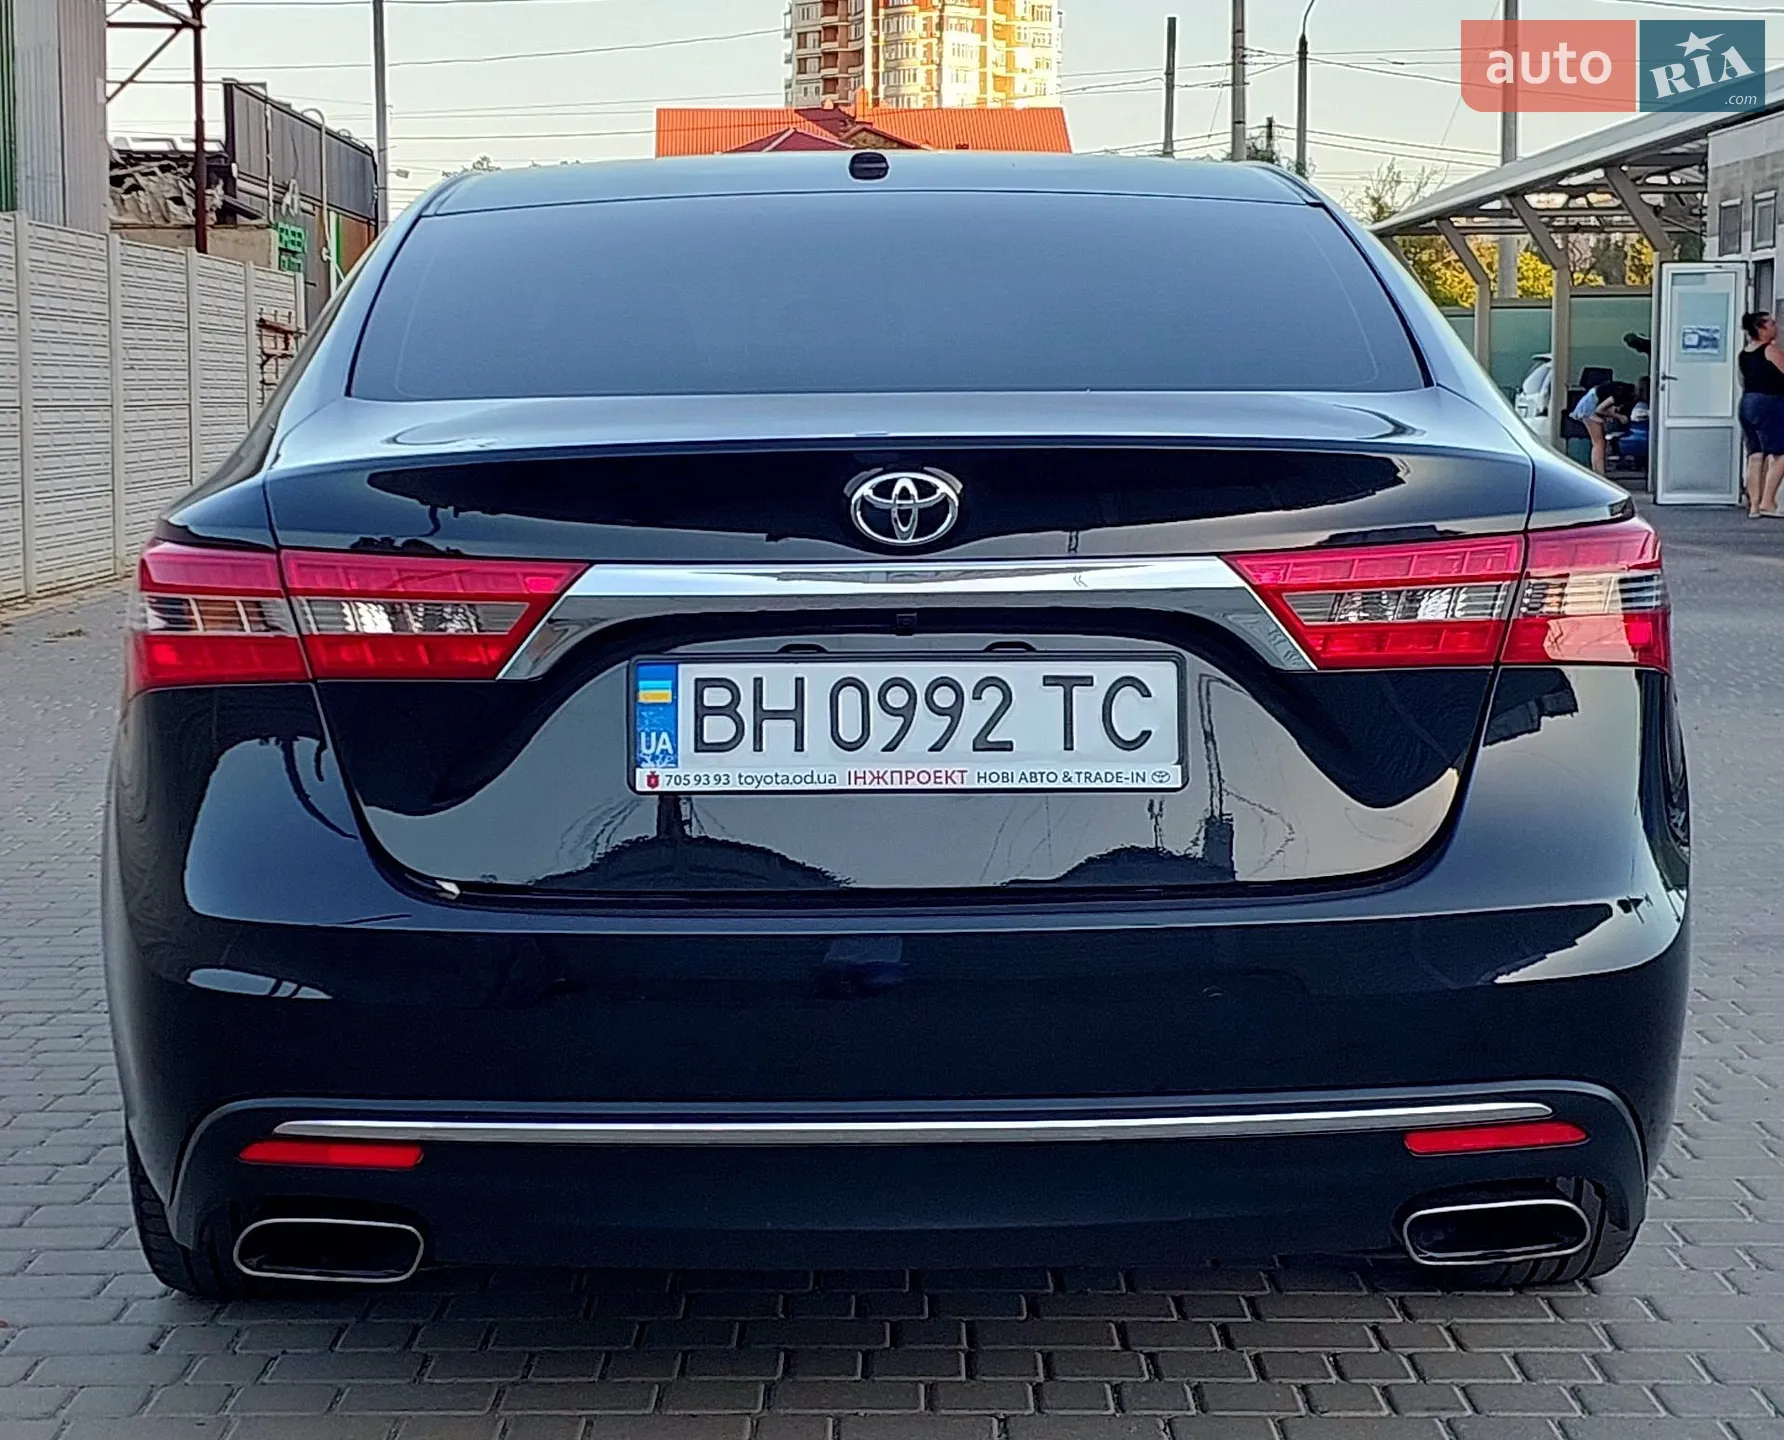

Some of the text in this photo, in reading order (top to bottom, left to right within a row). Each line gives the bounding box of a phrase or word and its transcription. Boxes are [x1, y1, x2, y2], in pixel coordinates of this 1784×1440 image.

[693, 674, 1153, 754] BH 0992 TC
[640, 731, 674, 755] UA
[738, 770, 837, 788] toyota.od.ua
[847, 769, 968, 786] ІНЖПРОЕКТ
[976, 771, 1014, 784] НОВІ
[1018, 771, 1058, 784] АВТО
[1075, 771, 1147, 783] TRADE-IN
